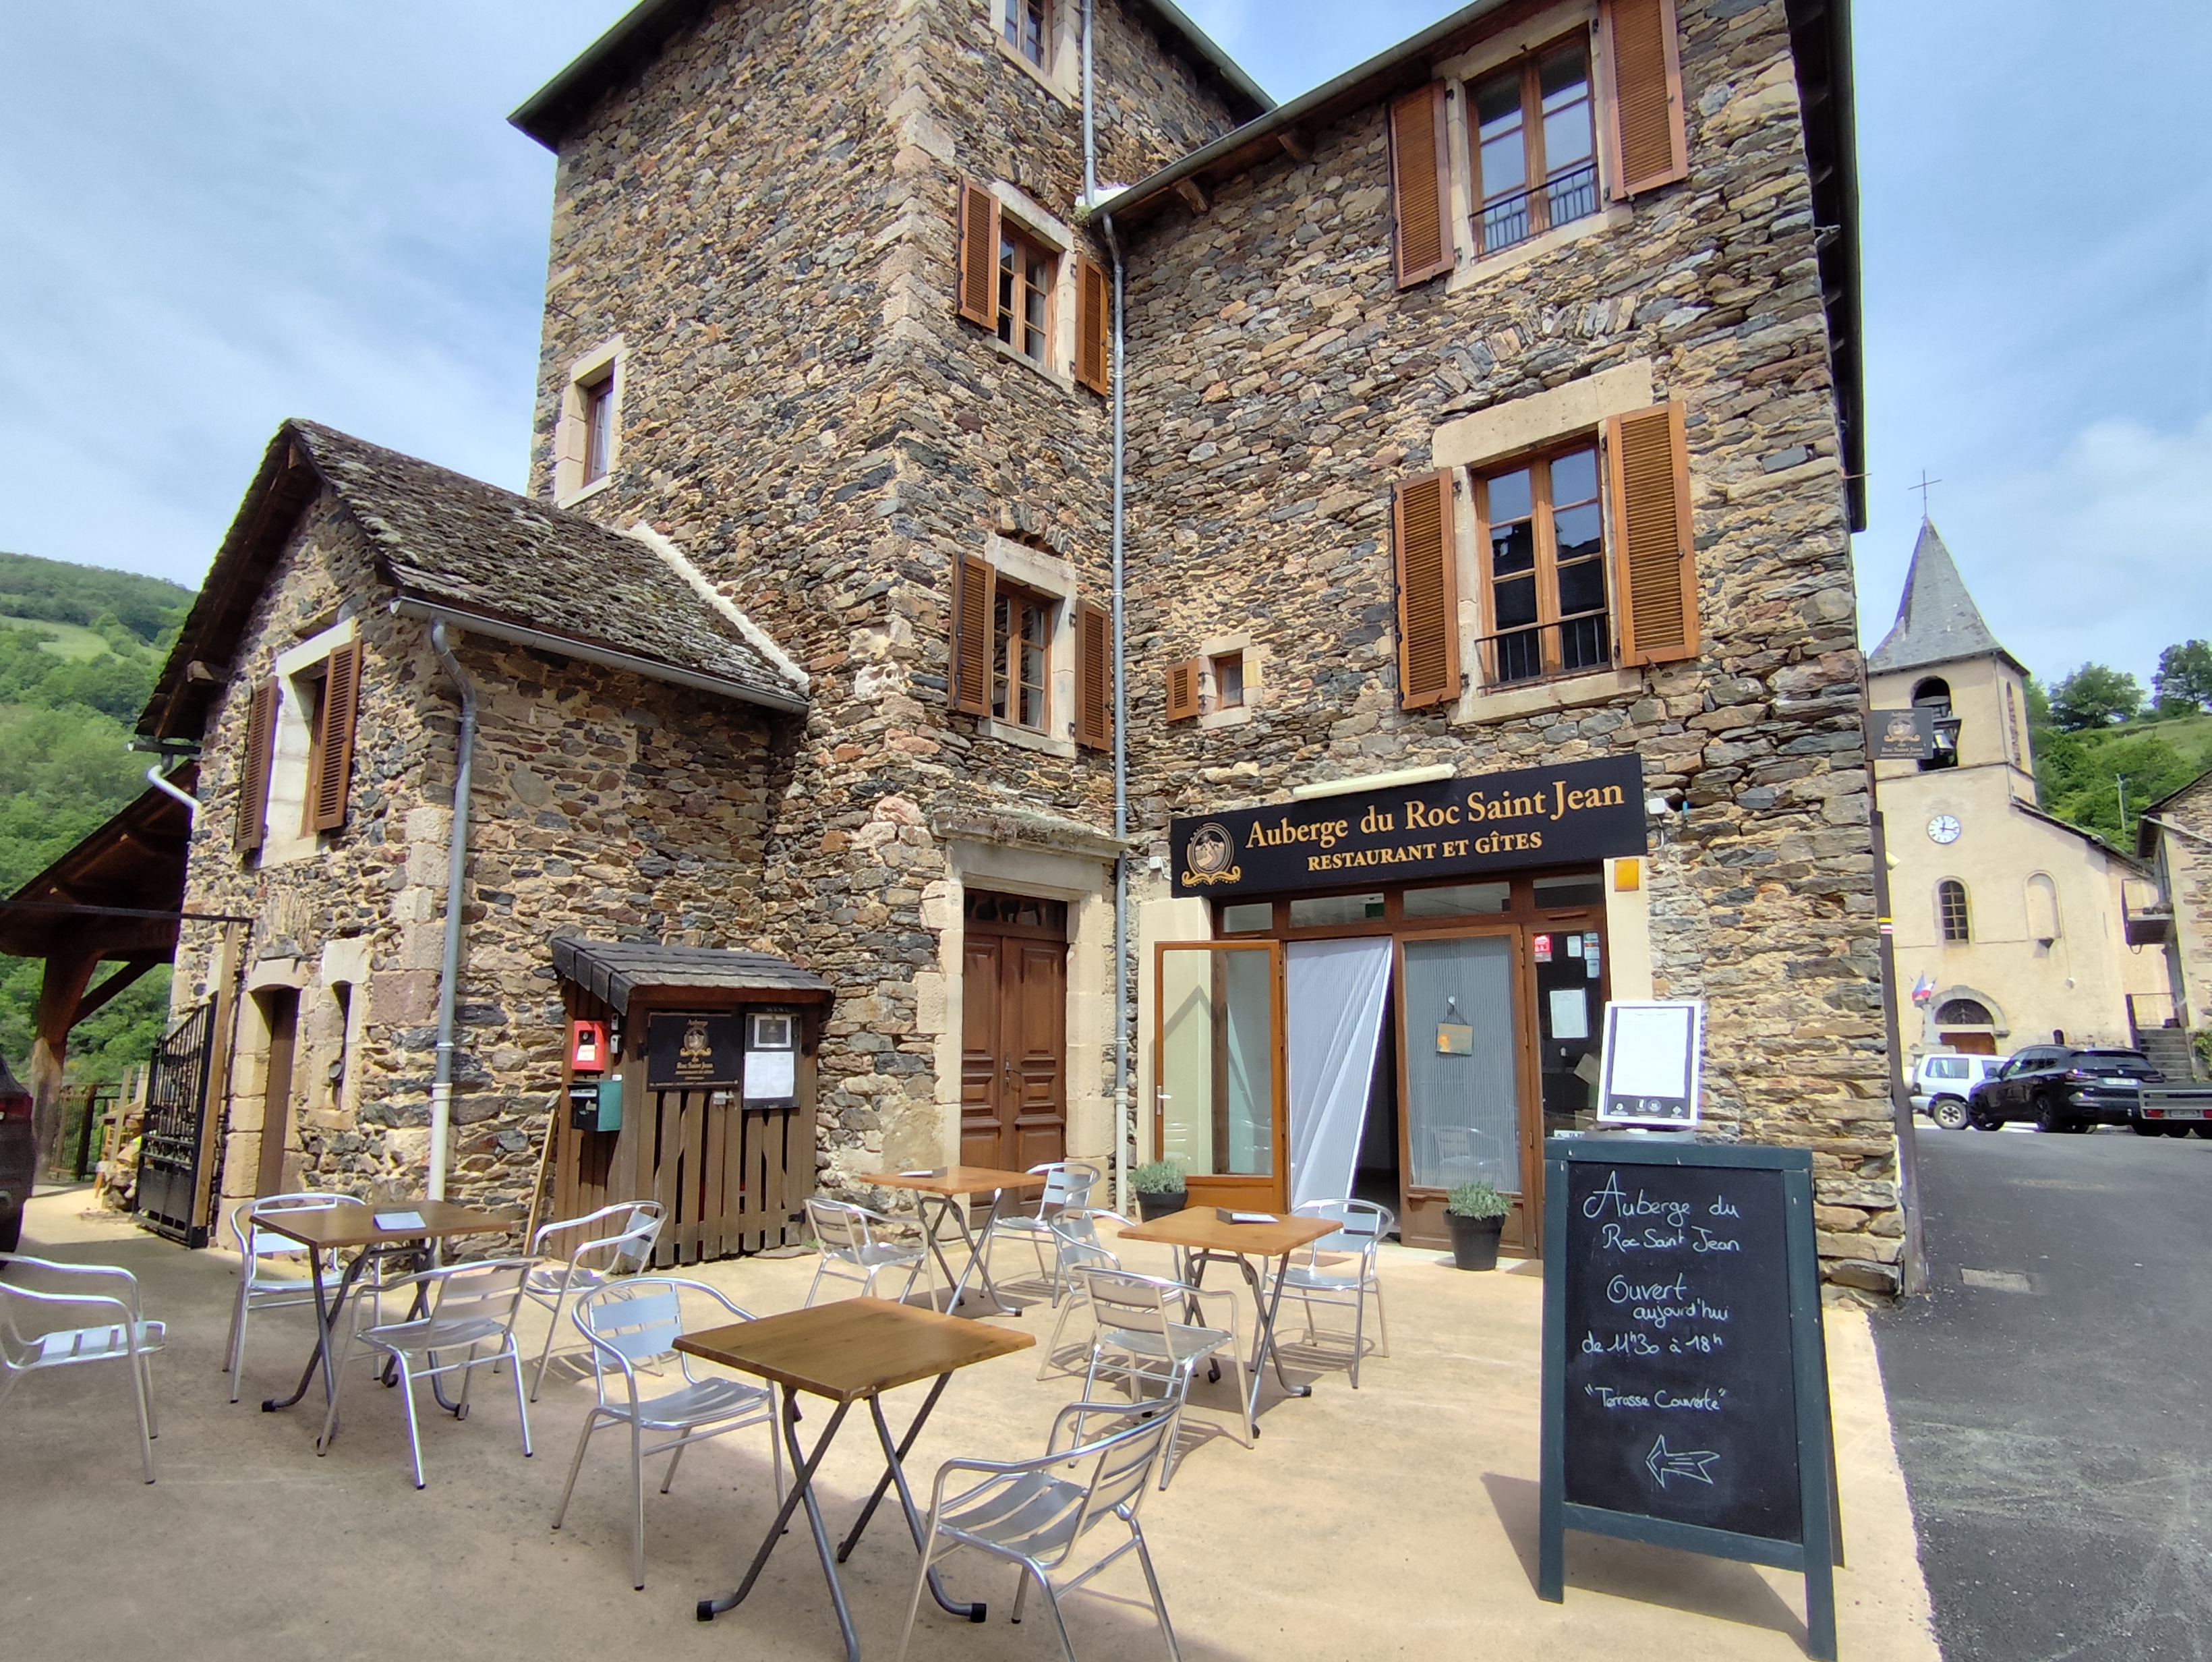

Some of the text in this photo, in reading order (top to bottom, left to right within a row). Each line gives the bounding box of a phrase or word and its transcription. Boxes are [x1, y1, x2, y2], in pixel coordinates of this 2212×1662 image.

[1246, 780, 1625, 849] Auberge du Roc Saint Jean
[1308, 830, 1542, 871] RESTAURANT ET GÎTES
[1583, 1170, 1741, 1227] Auberge du
[1602, 1223, 1740, 1253] Roc Saint Jean
[1606, 1272, 1687, 1303] Ouvert
[1633, 1298, 1729, 1329] aujourd'hui
[1582, 1330, 1723, 1355] de 11h30 à 18h
